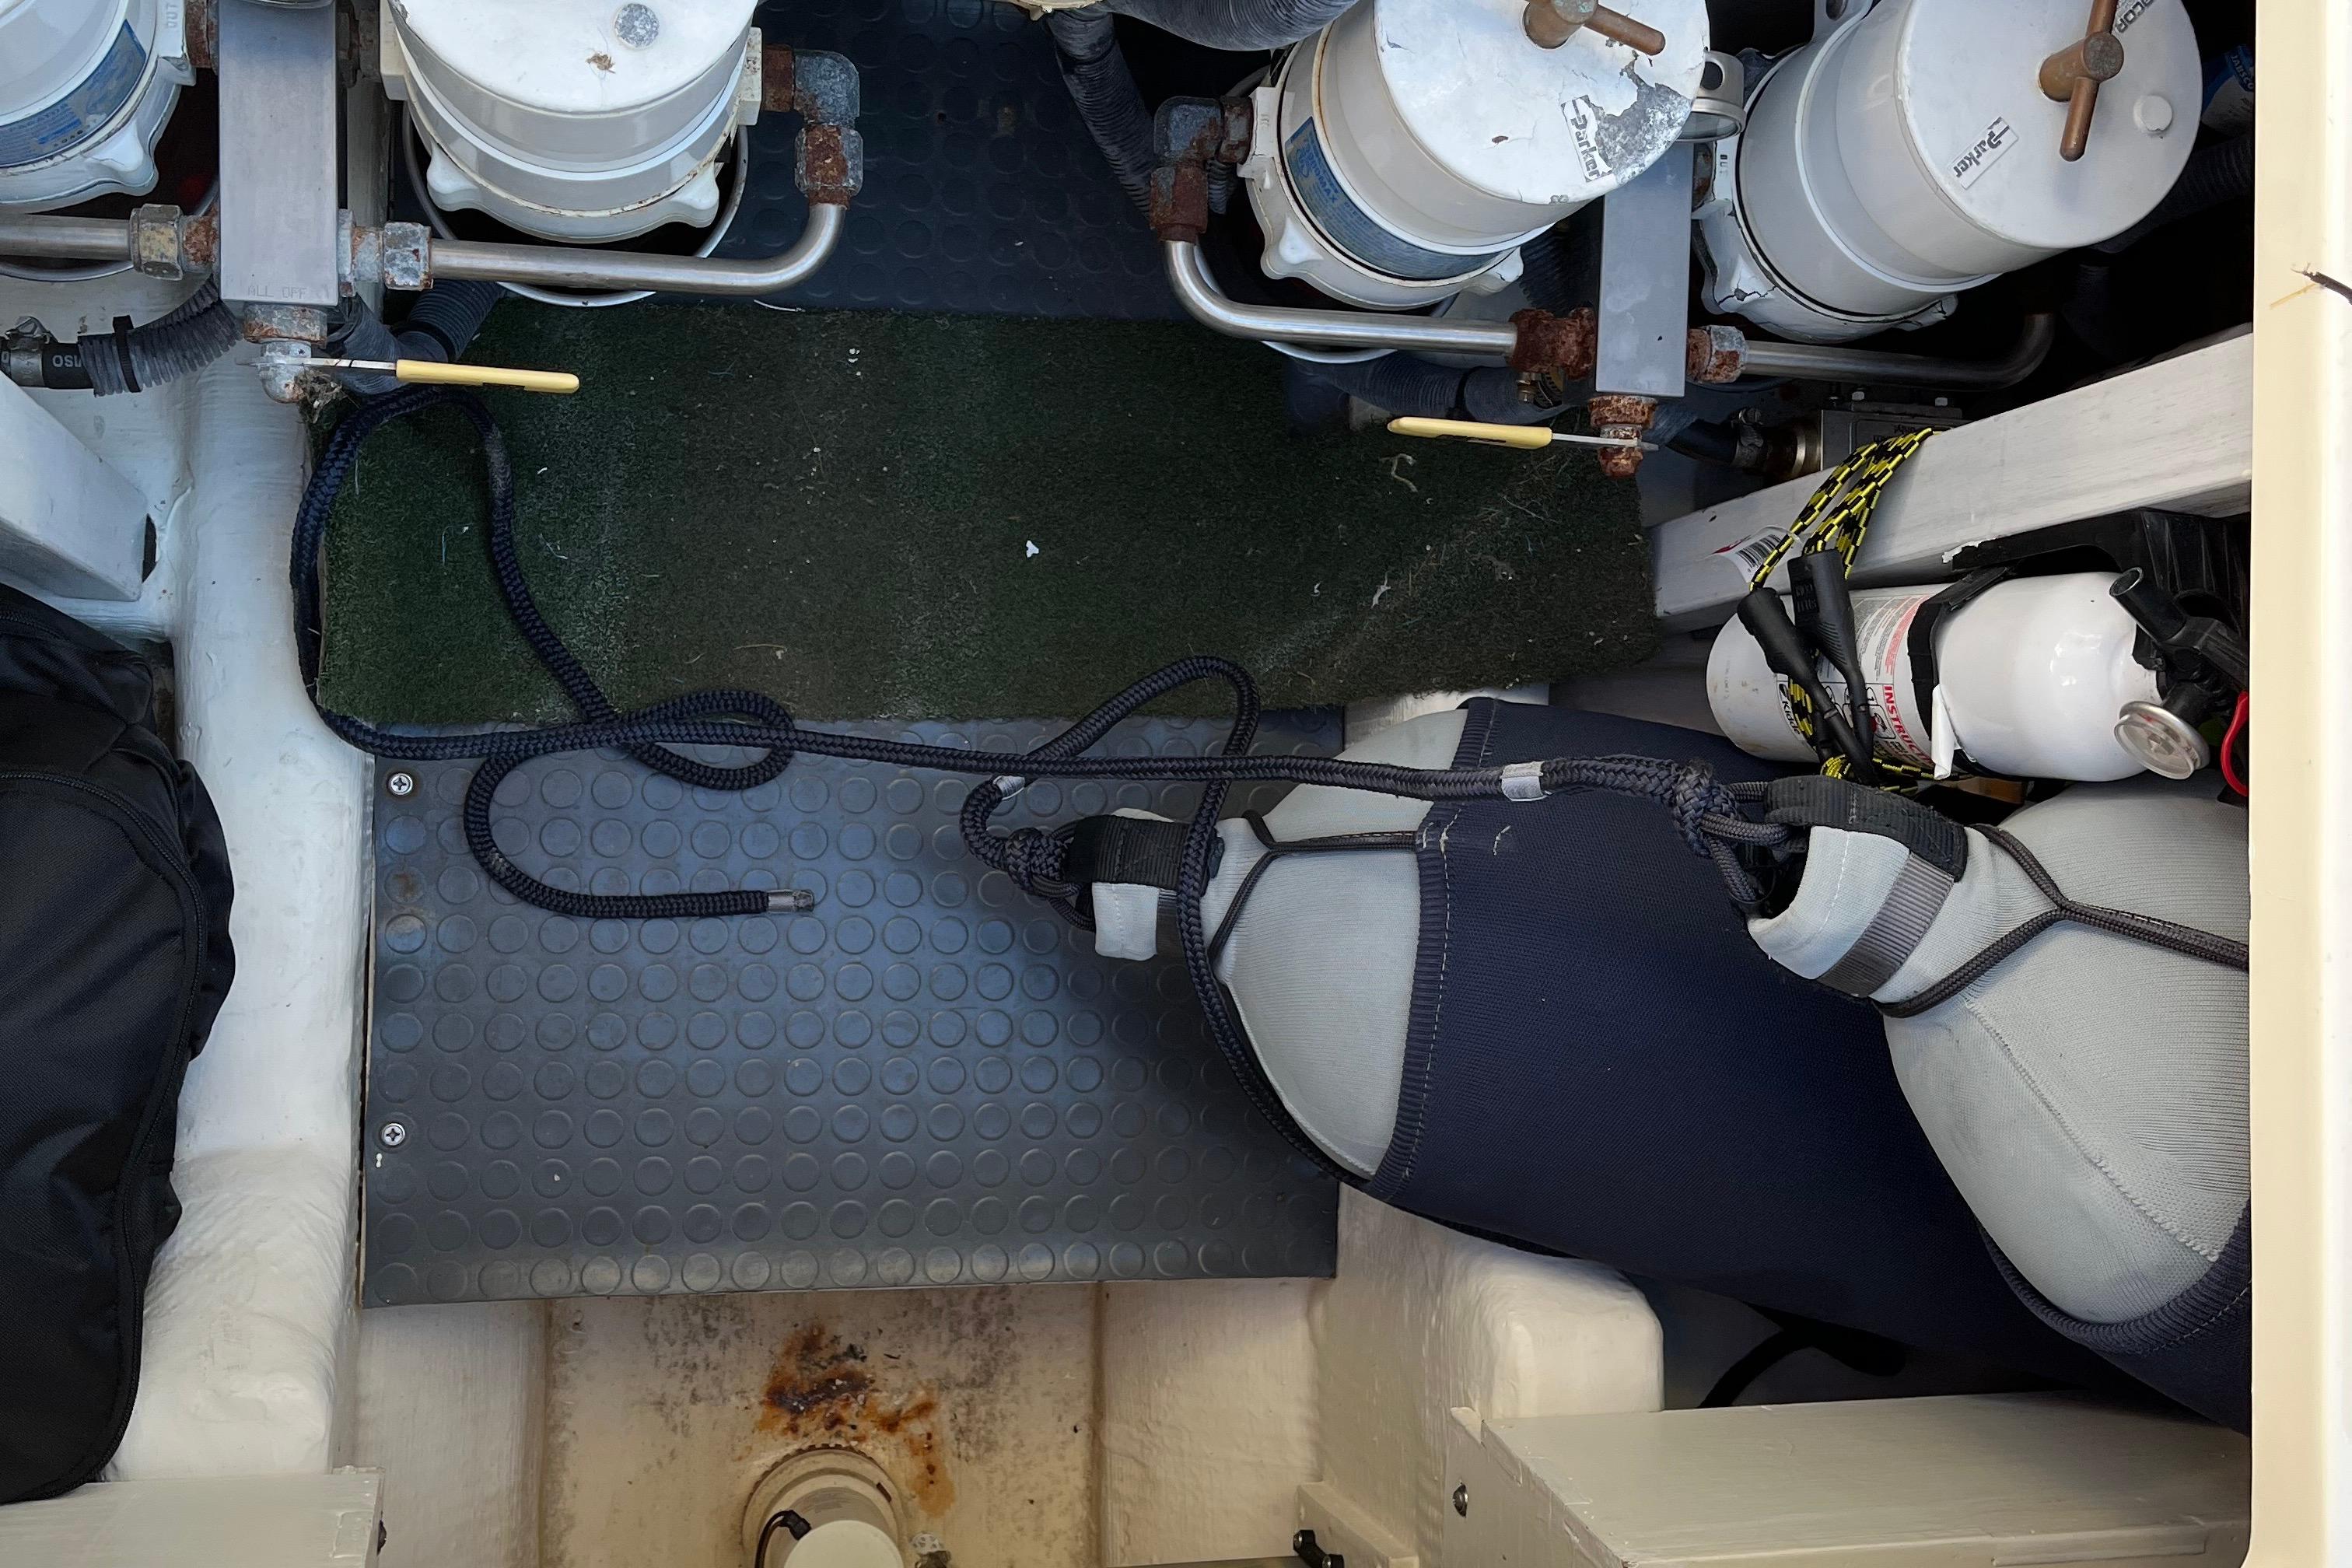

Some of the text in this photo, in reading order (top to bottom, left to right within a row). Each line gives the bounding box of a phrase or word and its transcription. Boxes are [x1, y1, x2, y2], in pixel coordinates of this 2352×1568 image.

[1570, 114, 1601, 177] Parker
[1953, 129, 2004, 178] Parker
[248, 285, 307, 299] ALL OFF
[1782, 701, 1801, 735] Kidde
